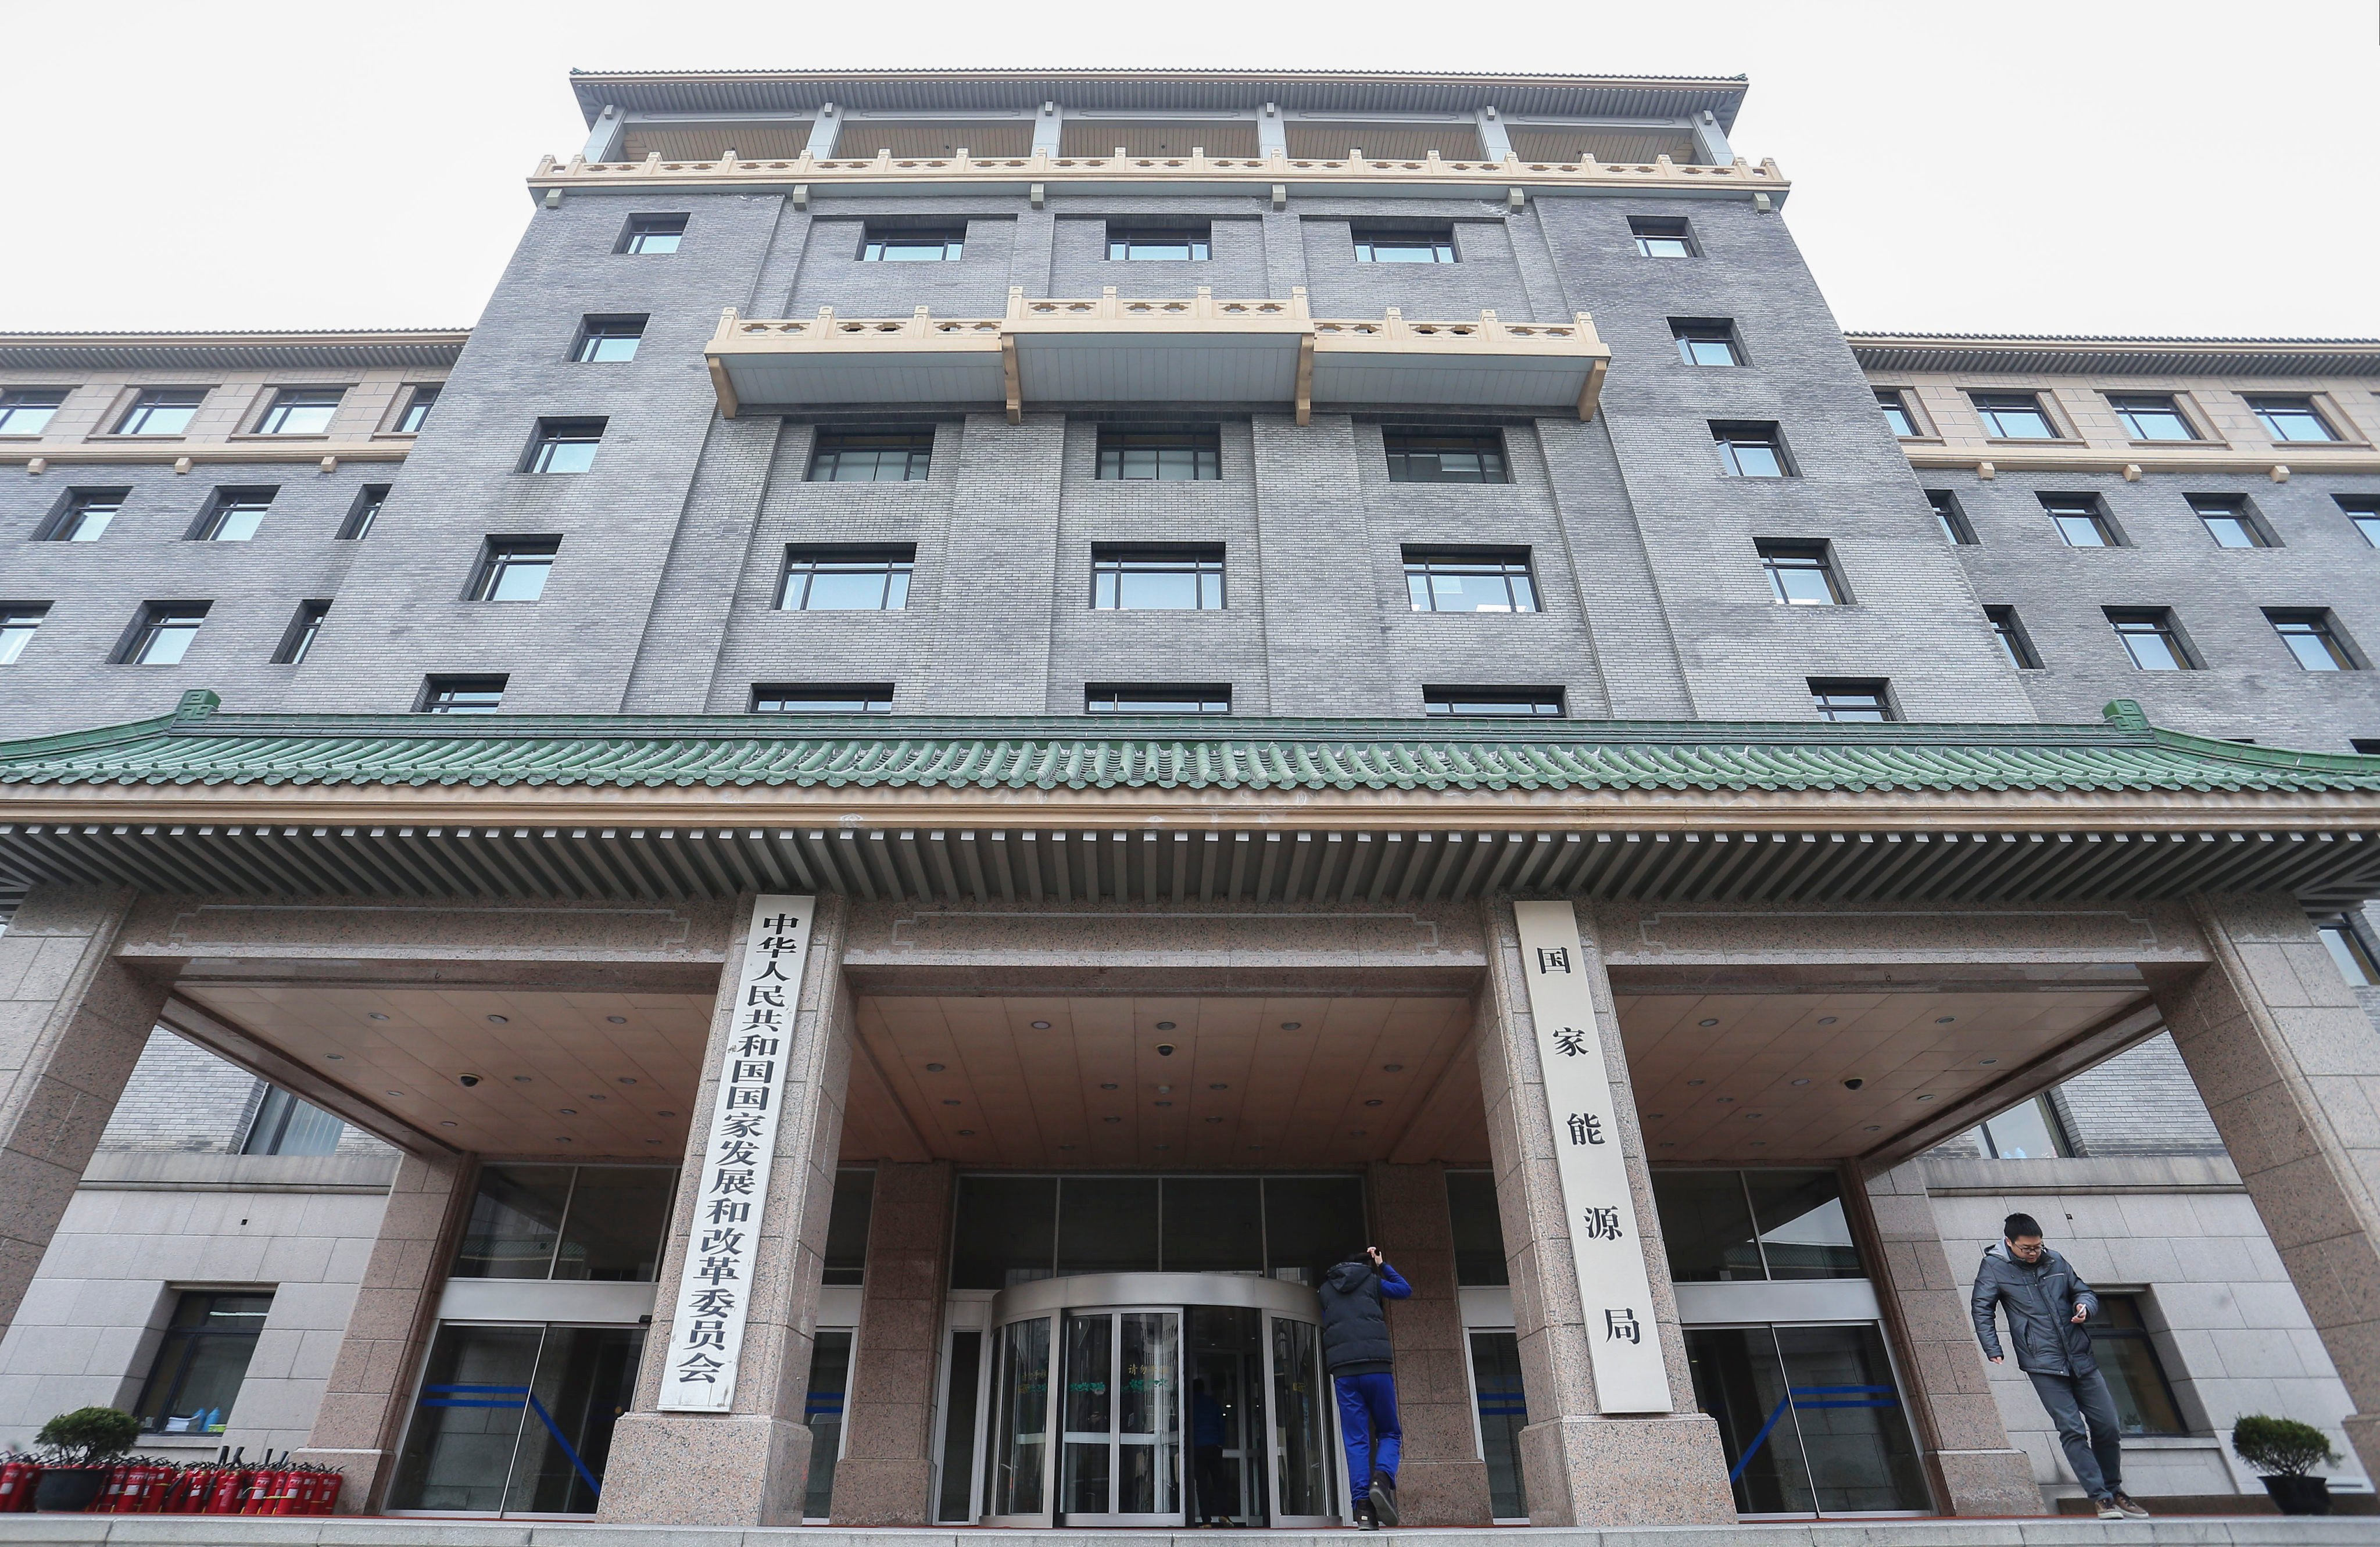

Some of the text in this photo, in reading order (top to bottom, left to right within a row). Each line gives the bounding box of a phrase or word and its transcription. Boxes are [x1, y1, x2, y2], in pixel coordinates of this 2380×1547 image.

[677, 913, 799, 1384] 中华人民共和国国家发展和改革委员会
[1537, 946, 1640, 1344] 国家能源局
